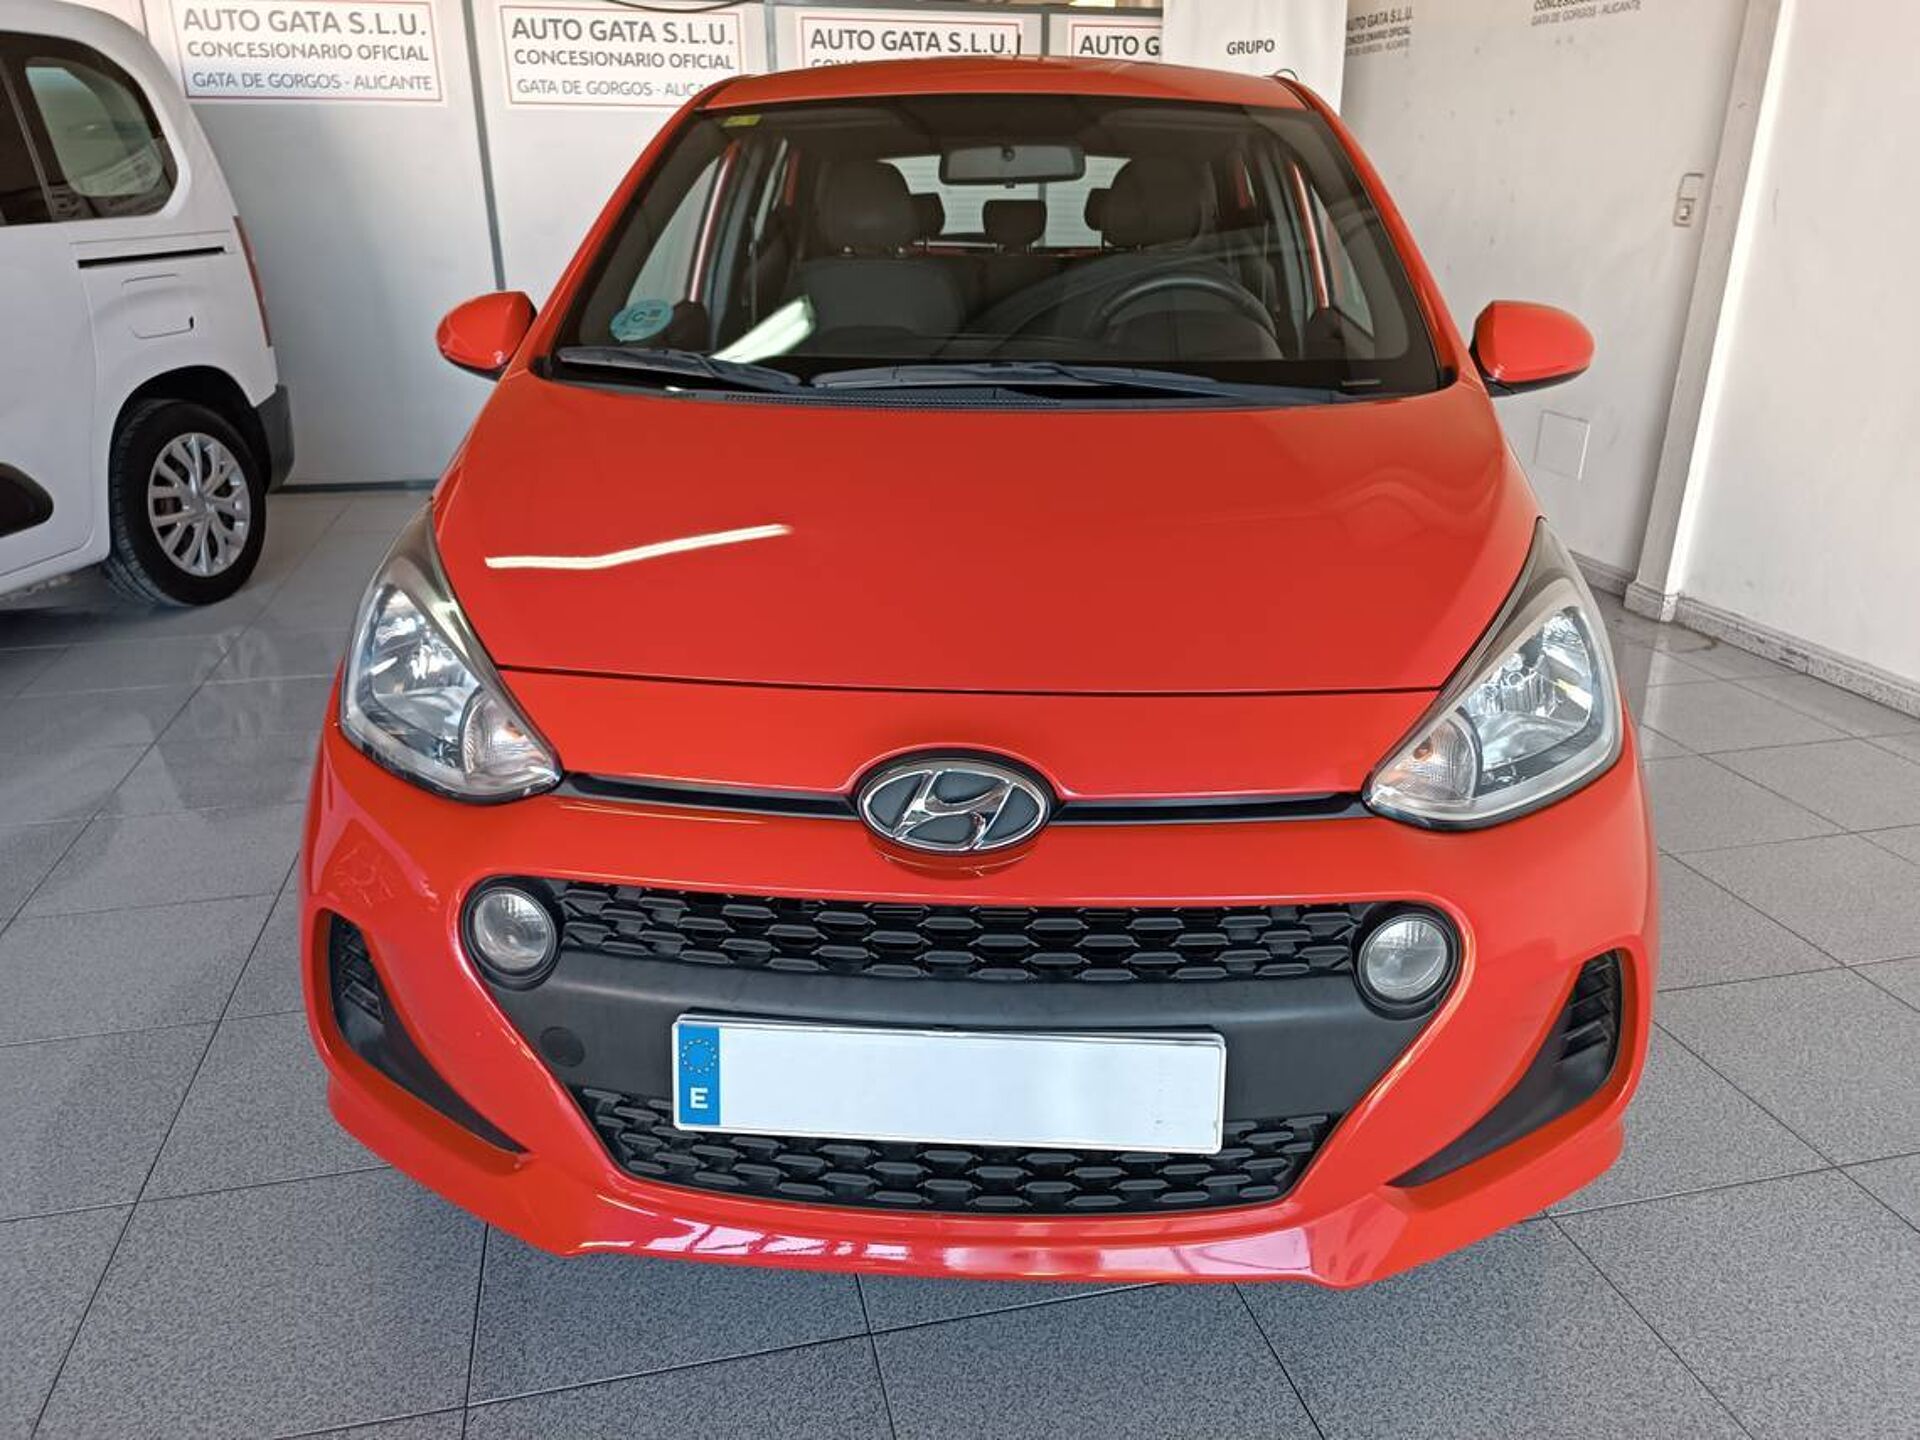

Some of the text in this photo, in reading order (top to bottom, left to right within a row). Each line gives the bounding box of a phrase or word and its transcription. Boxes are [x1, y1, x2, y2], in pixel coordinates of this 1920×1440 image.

[183, 8, 427, 36] AUTO GATA S.L.U.
[512, 17, 734, 45] AUTO GATA S.L.U.
[187, 41, 430, 61] CONCESIONARIO OFICIAL
[810, 28, 1012, 54] AUTO GATA S.L.U.
[1079, 35, 1140, 56] AUTO
[1226, 39, 1276, 55] GRUPO
[514, 49, 735, 70] CONCESIONARIO OFICIAL
[192, 71, 237, 88] GATA
[241, 72, 264, 89] DE
[267, 73, 342, 90] GORGOS
[353, 74, 433, 92] ALICANTE
[516, 79, 559, 94] GATA
[562, 80, 583, 95] DE
[586, 80, 653, 97] GORGOS
[690, 1087, 709, 1109] E
